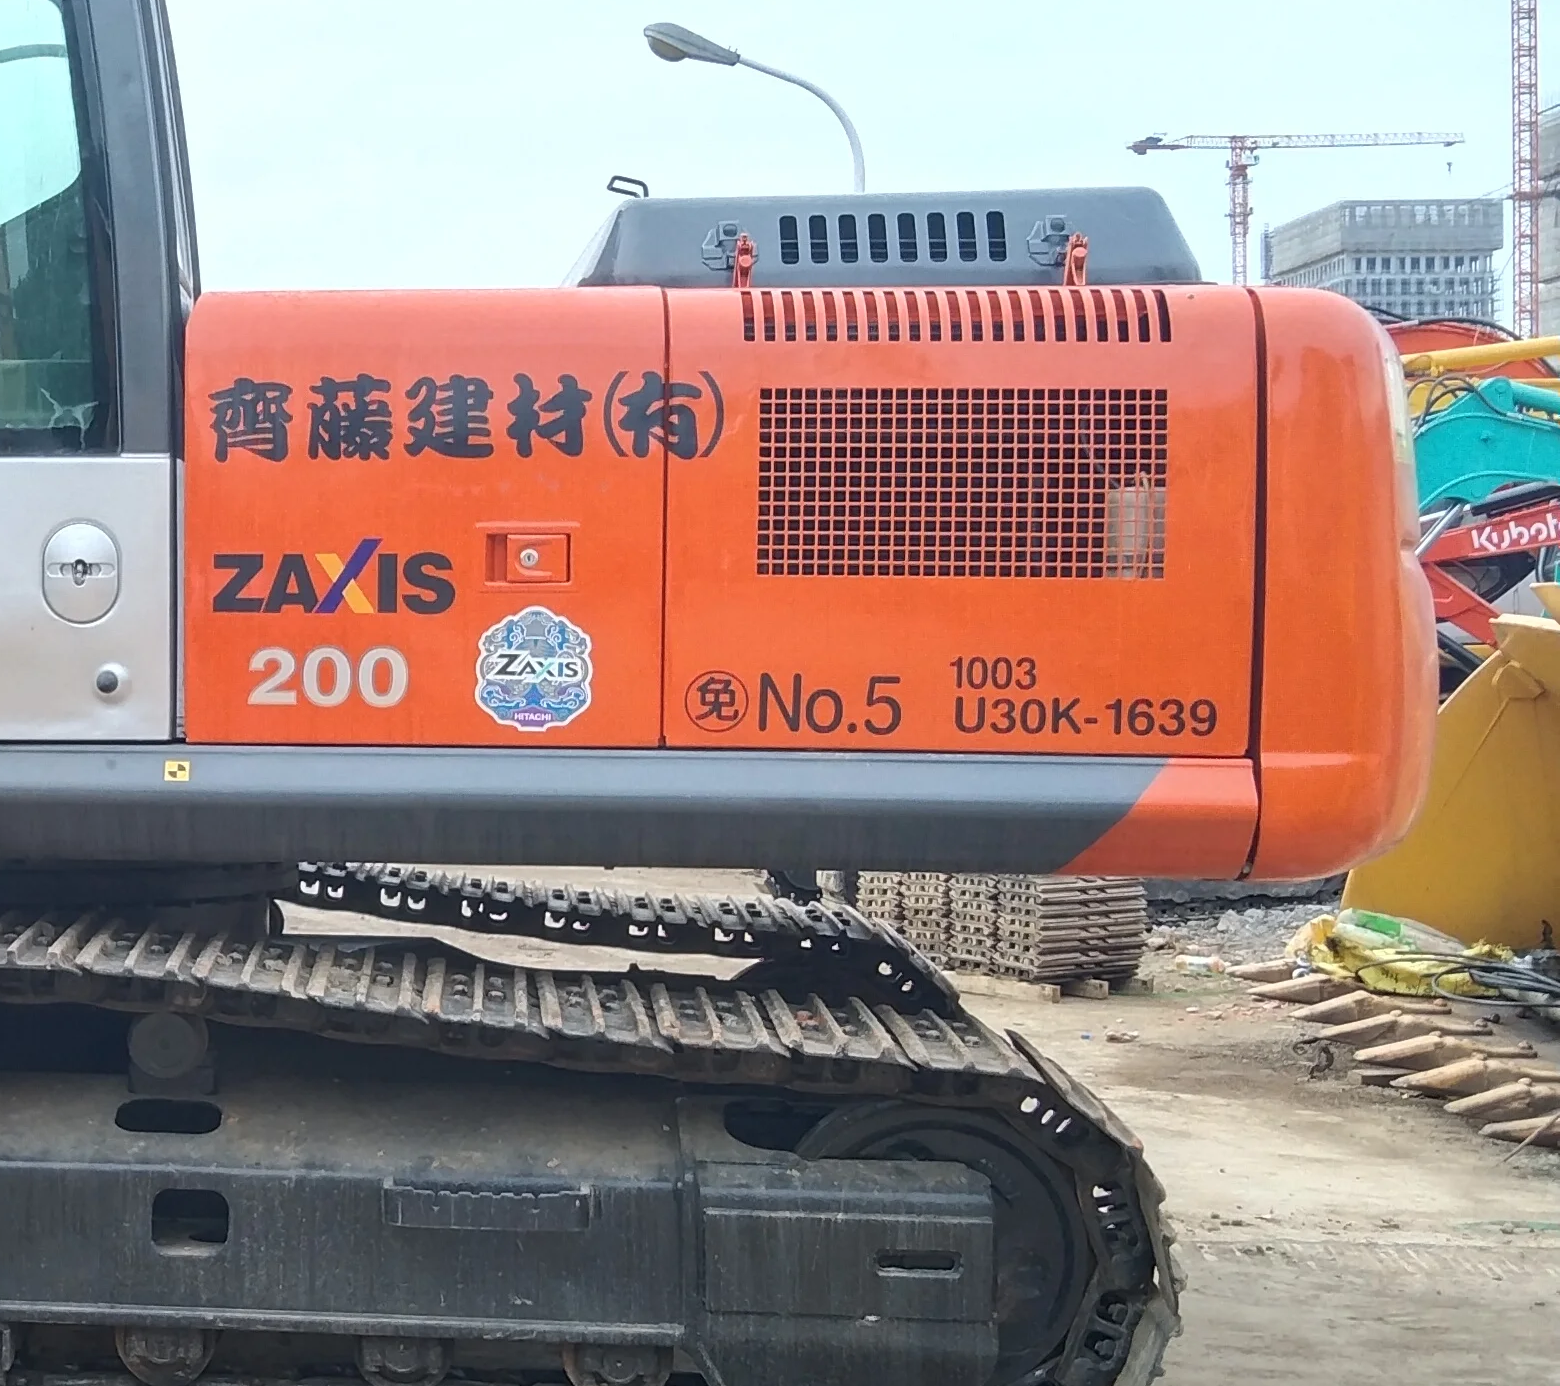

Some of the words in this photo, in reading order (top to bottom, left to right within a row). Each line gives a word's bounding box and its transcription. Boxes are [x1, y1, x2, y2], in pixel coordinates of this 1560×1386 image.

[1471, 513, 1560, 553] Kubot
[212, 538, 456, 615] ZAXIS
[247, 645, 409, 708] 200
[494, 653, 579, 678] ZAXIS
[950, 656, 1037, 690] 1003
[514, 713, 552, 721] HITACHI
[758, 672, 903, 736] No.5
[955, 696, 1218, 737] U30K-1639
